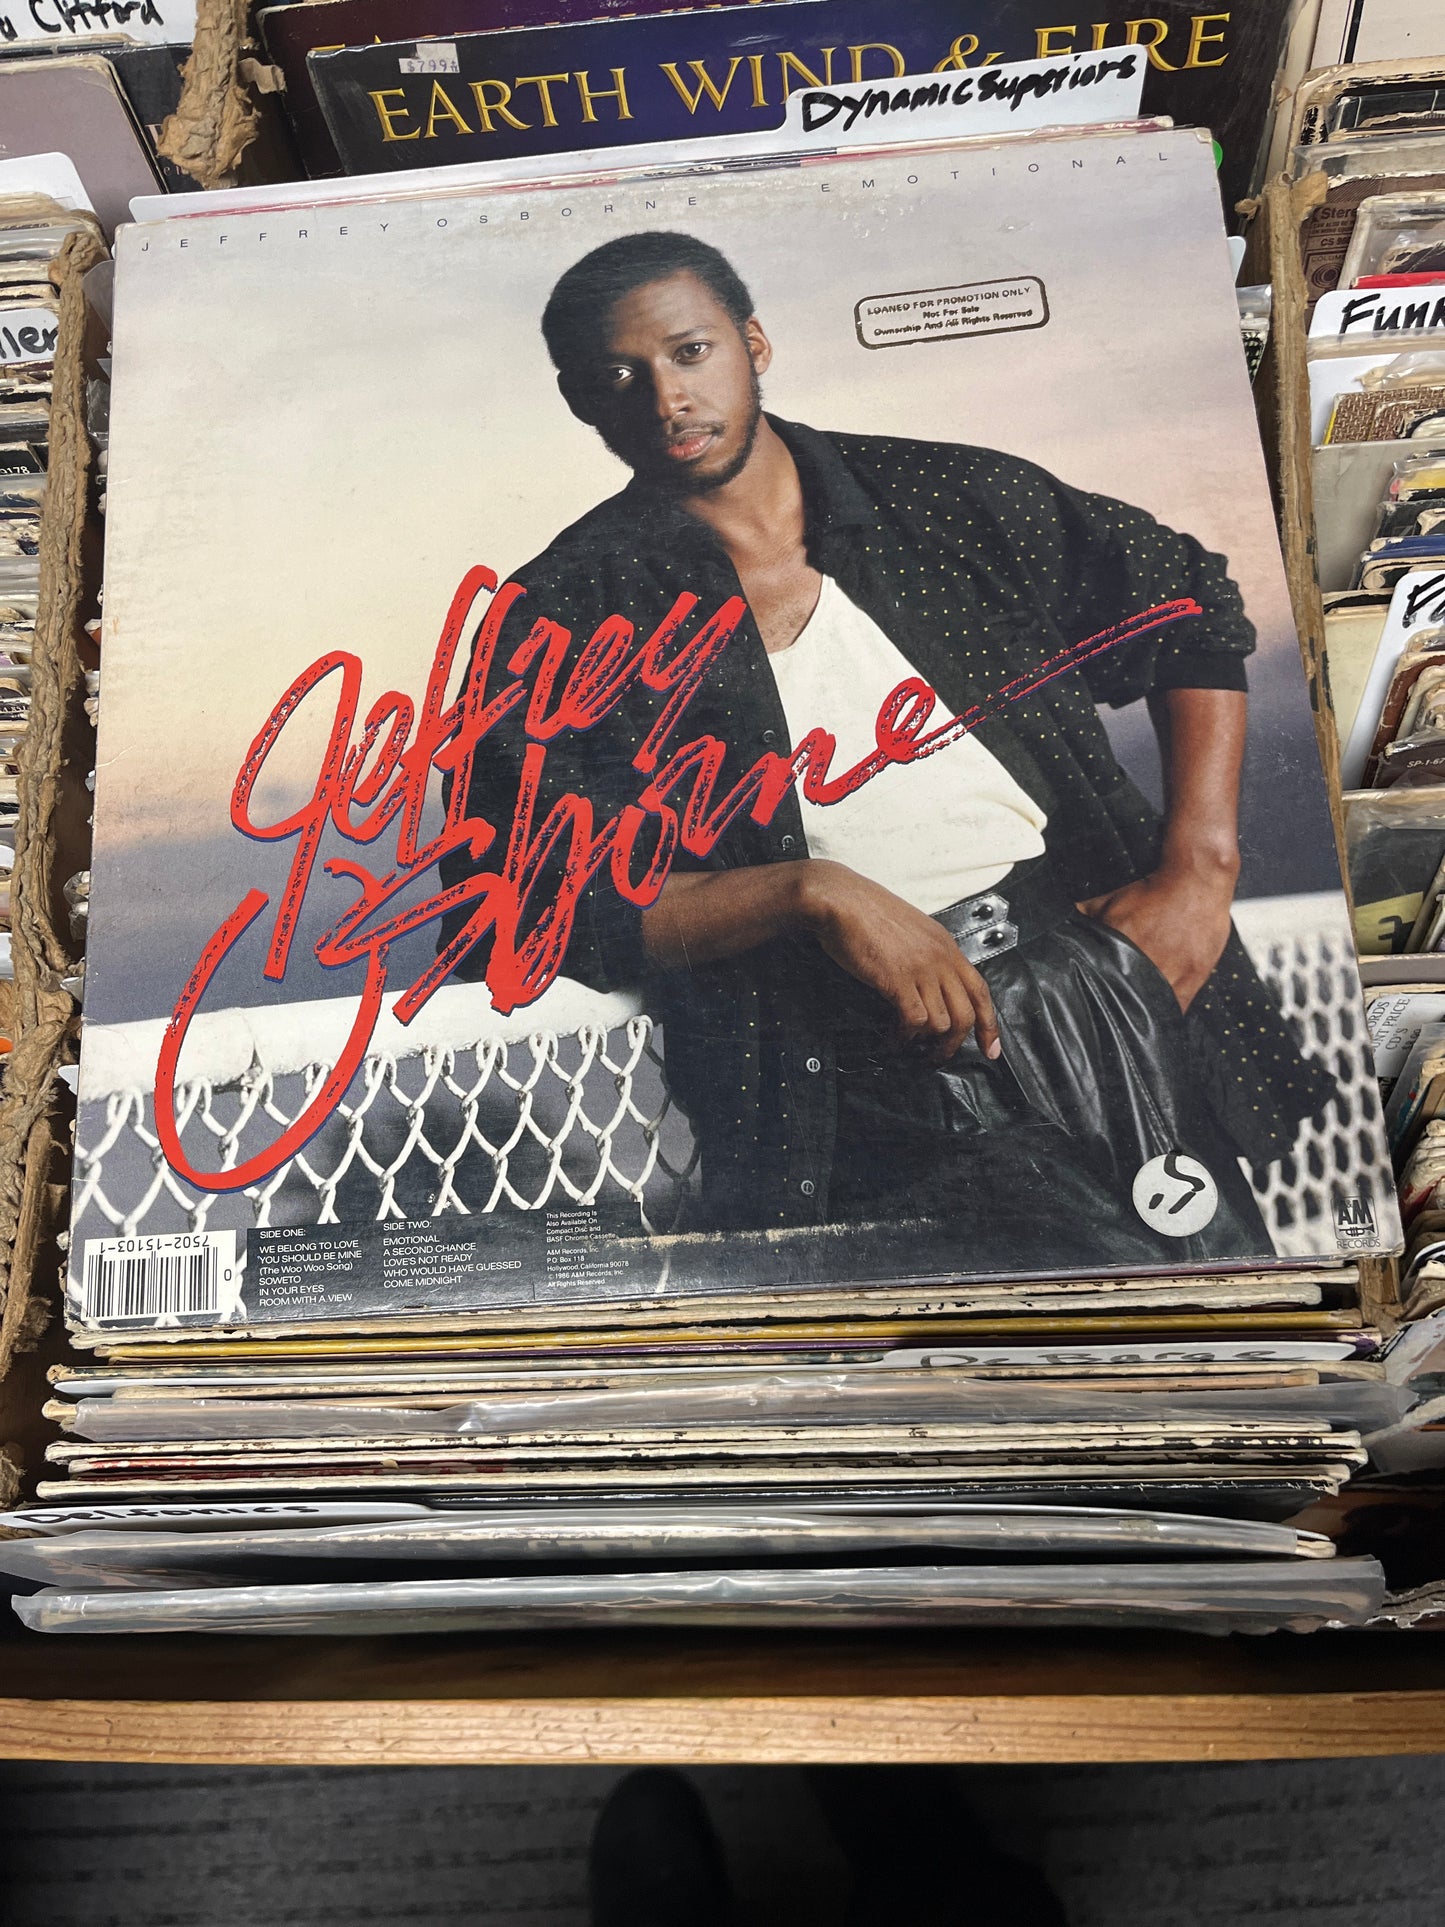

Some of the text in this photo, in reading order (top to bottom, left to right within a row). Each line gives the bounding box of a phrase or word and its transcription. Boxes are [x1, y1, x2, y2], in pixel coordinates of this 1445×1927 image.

[368, 66, 636, 143] EARTH
[658, 42, 906, 116] WIND
[141, 151, 1169, 253] JEFFREY OSBORNE EMOTIONAL
[867, 286, 1031, 316] LOANED FOR PROMOTION ONLY
[922, 305, 980, 320] Not For Sale
[874, 309, 1033, 337] Ownership And All Rights Reserved
[231, 563, 747, 984] Jeffrey
[1367, 1000, 1390, 1029] ORDS
[1382, 998, 1412, 1027] PRICE
[560, 1210, 591, 1219] Recording
[383, 1220, 432, 1231] SIDE TWO:
[560, 1218, 587, 1227] Available
[259, 1228, 306, 1239] SIDE ONE:
[546, 1228, 574, 1236] Compact
[564, 1234, 589, 1242] Chrome
[259, 1239, 359, 1254] WE BELONG TO LOVE
[383, 1234, 440, 1247] EMOTIONAL
[1336, 1238, 1381, 1250] RECORDS
[383, 1242, 477, 1257] A SECOND CHANCE
[259, 1249, 363, 1265] YOU SHOULD BE MINE
[383, 1253, 473, 1268] LOVE'S NOT READY
[259, 1262, 353, 1277] (The Woo Woo Song)
[383, 1260, 522, 1278] WHO WOULD HAVE GUESSED
[580, 1262, 609, 1270] California
[258, 1275, 302, 1286] SOWETO
[383, 1275, 463, 1289] COME MIDNIGHT
[556, 1280, 576, 1289] Rights
[259, 1284, 325, 1296] IN YOUR EYES
[259, 1293, 353, 1307] ROOM WITH A VIEW
